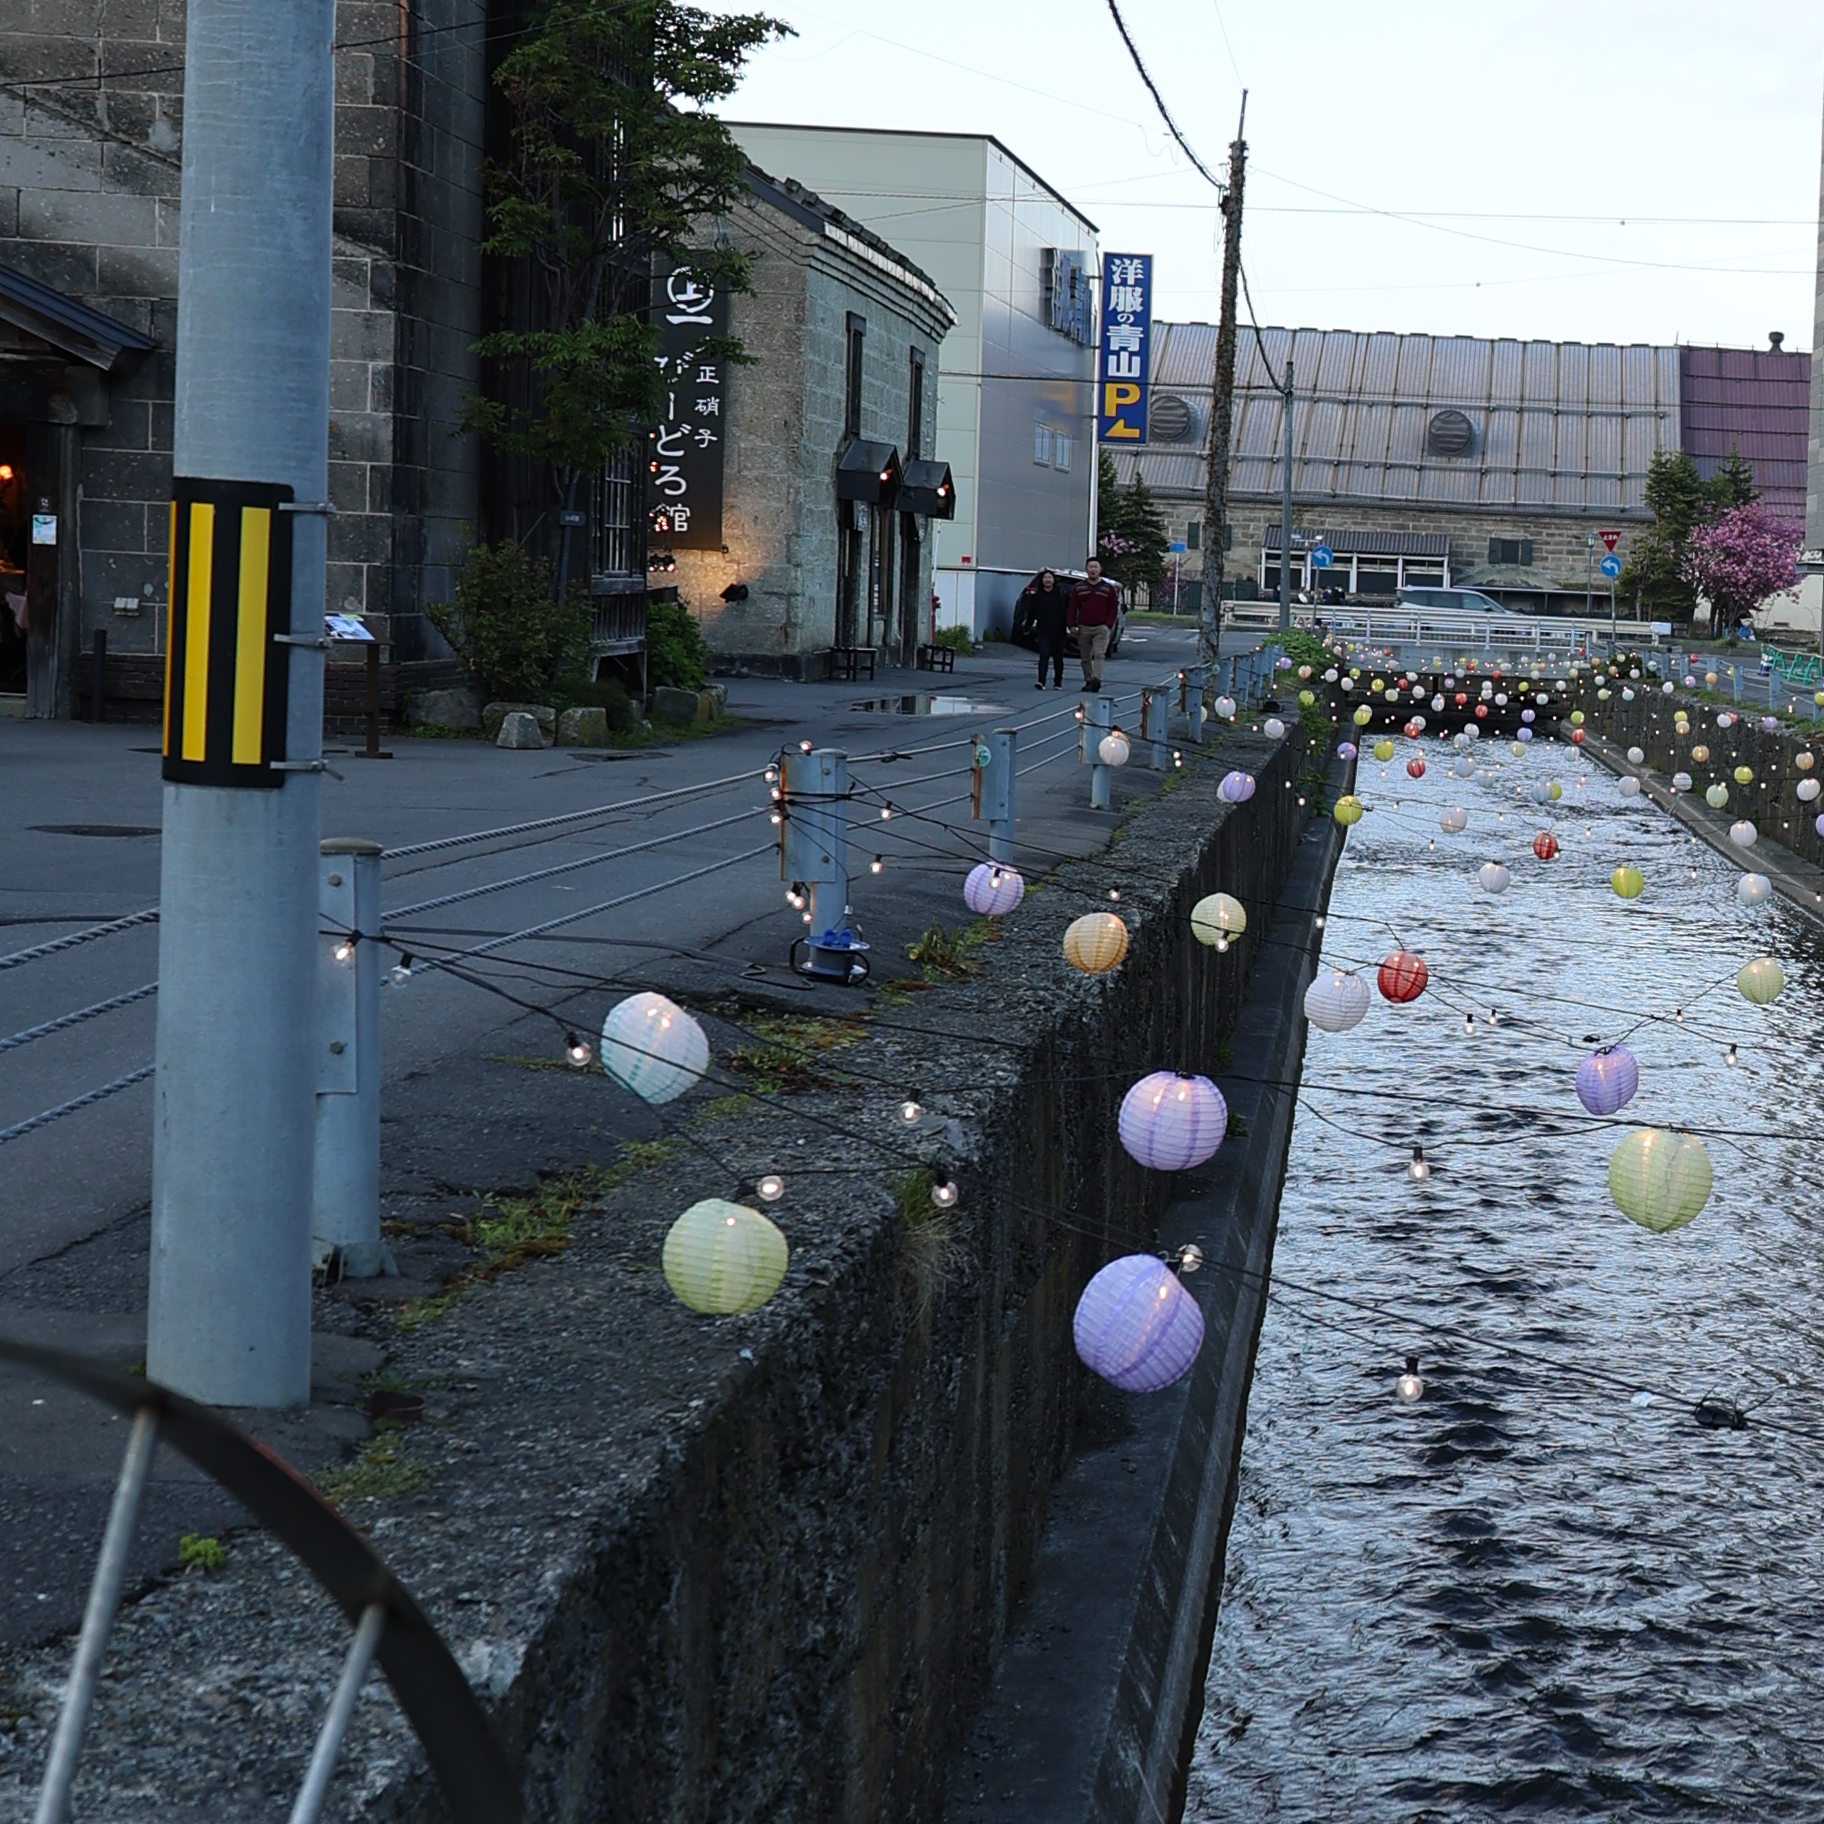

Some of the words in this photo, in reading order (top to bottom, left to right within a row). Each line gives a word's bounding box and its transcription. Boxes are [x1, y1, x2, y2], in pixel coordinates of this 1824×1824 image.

[1106, 258, 1144, 378] 洋服の青山
[693, 336, 721, 448] 正硝子
[1104, 383, 1142, 417] P
